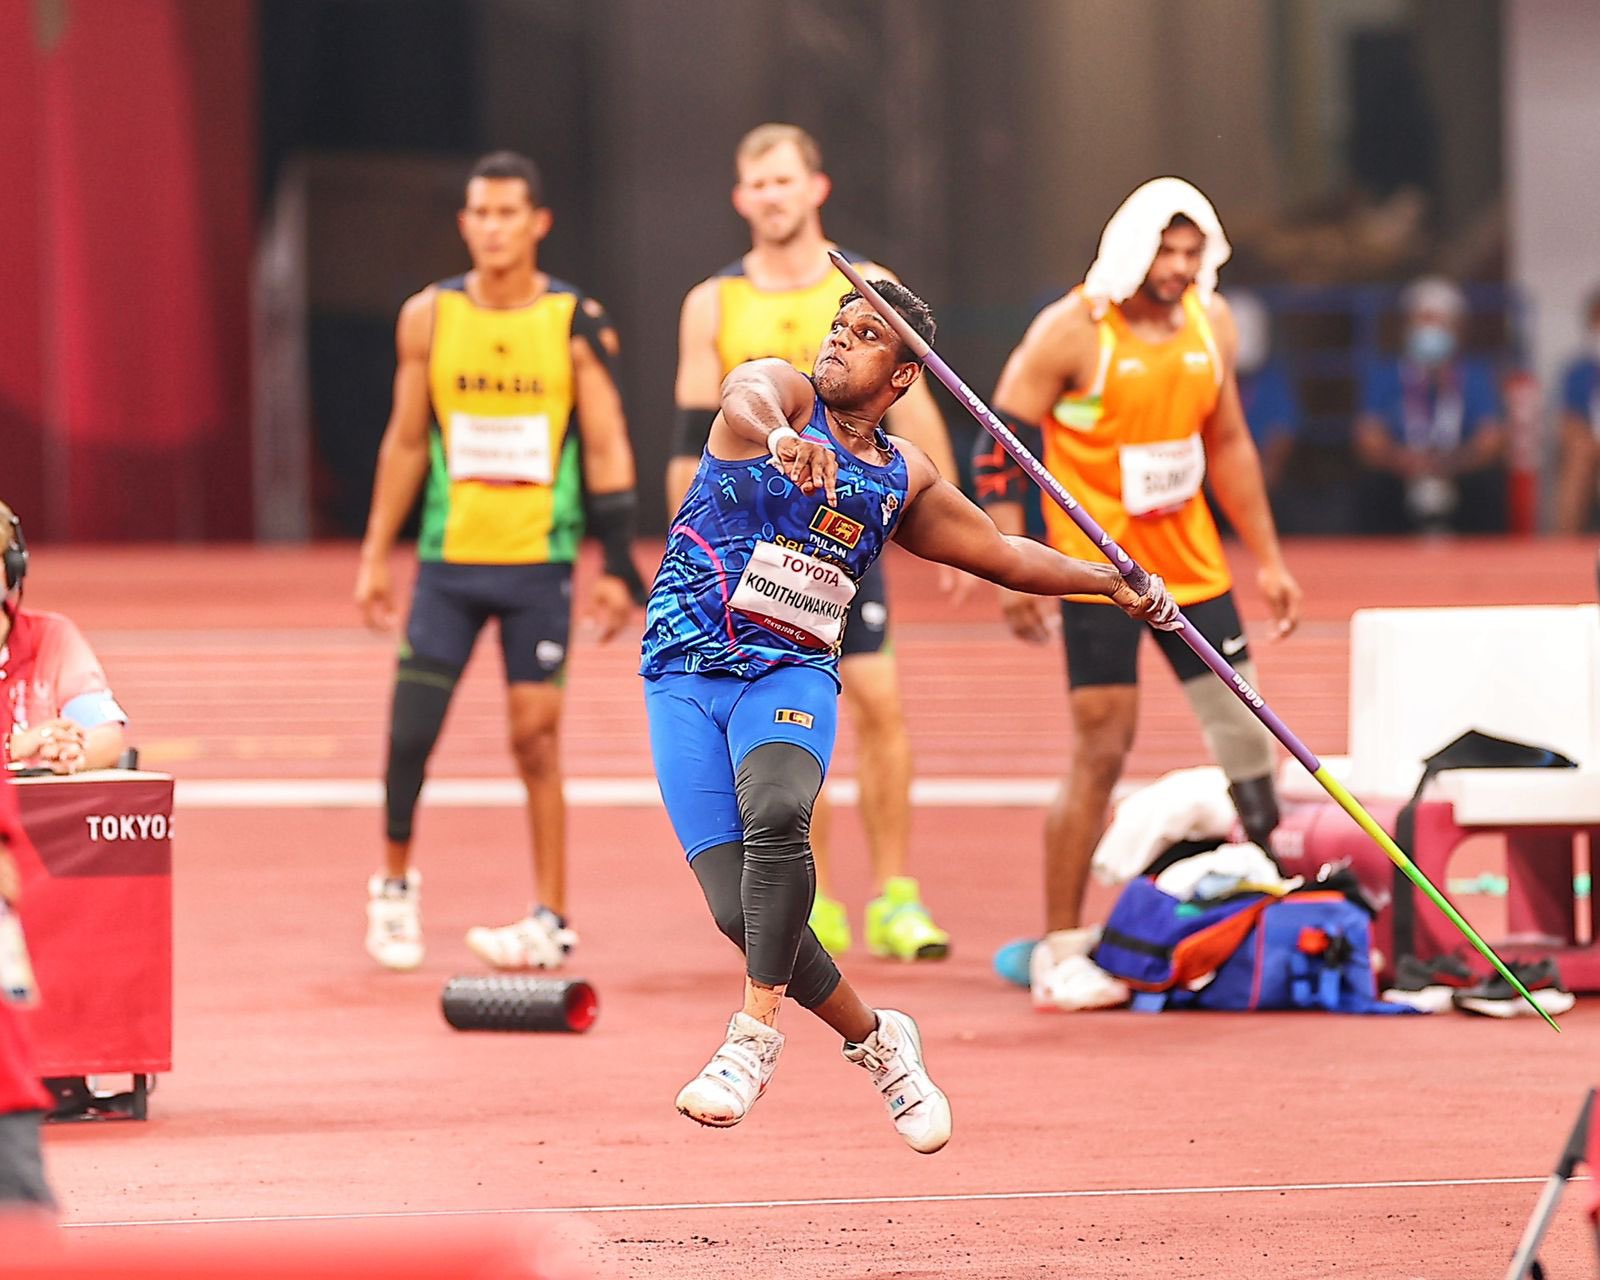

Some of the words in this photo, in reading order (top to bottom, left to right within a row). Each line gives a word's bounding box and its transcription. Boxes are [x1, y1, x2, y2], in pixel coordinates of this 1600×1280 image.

[809, 533, 847, 558] DULAN
[782, 553, 840, 587] TOYOTA
[745, 572, 843, 620] KODITHUWAKKU
[86, 814, 167, 841] TOKYO
